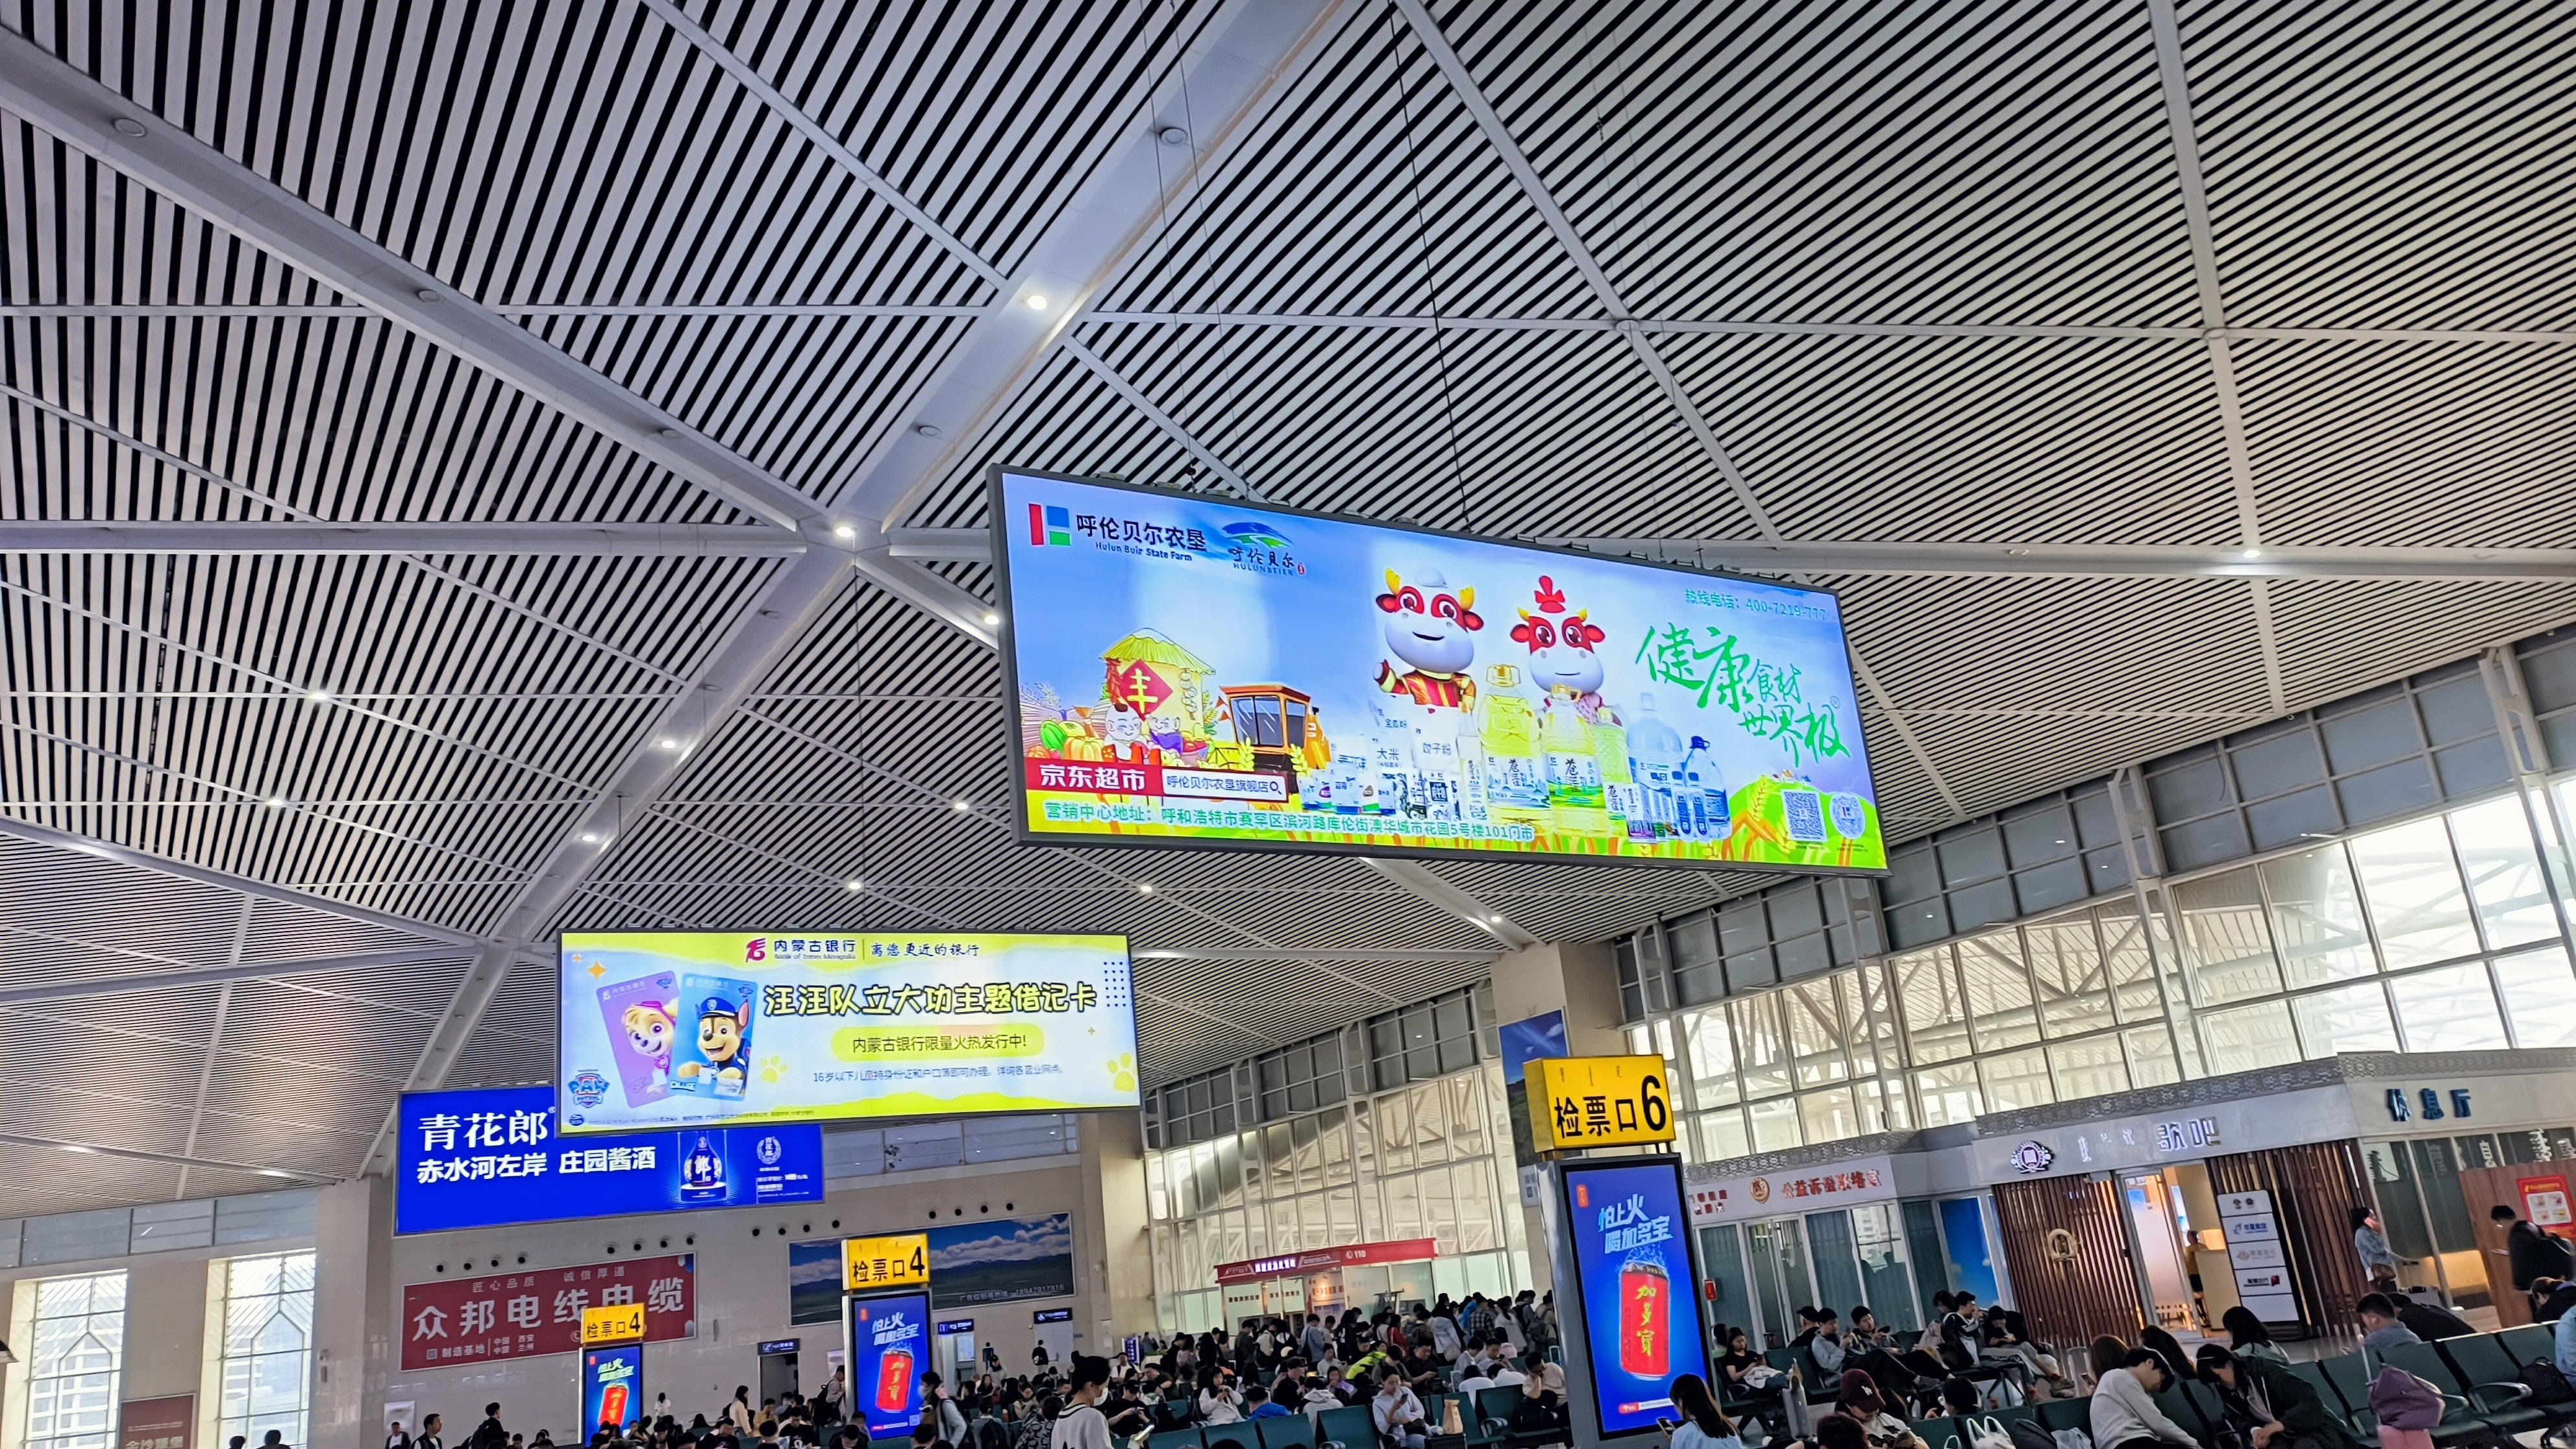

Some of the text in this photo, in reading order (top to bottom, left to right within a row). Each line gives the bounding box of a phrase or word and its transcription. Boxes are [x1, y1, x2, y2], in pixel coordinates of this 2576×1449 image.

[1076, 514, 1208, 552] 呼伦贝尔农垦
[1096, 541, 1193, 562] Hulun Buir State Farm
[1233, 562, 1294, 576] HULUNBEIER
[1635, 621, 1802, 713] 健康 食材
[1377, 747, 1399, 760] 大米
[1737, 702, 1851, 768] 世界极
[1039, 763, 1145, 791] 京东超市
[774, 939, 856, 953] 内蒙古银行
[871, 942, 980, 957] 离您更近的银行
[763, 982, 1098, 1017] 汪汪队立大功主题借记卡
[1554, 1074, 1666, 1139] 检票口6
[417, 1109, 548, 1152] 青花郎
[417, 1146, 656, 1183] 赤水河左岸 庄园酱酒
[1598, 1193, 1650, 1232] 怕上火
[1604, 1215, 1674, 1255] 喝加多宝
[852, 1246, 925, 1283] 检票口4
[1354, 1250, 1366, 1258] 110
[472, 1276, 535, 1293] 匠心品质
[412, 1277, 686, 1342] 众邦电线电缆
